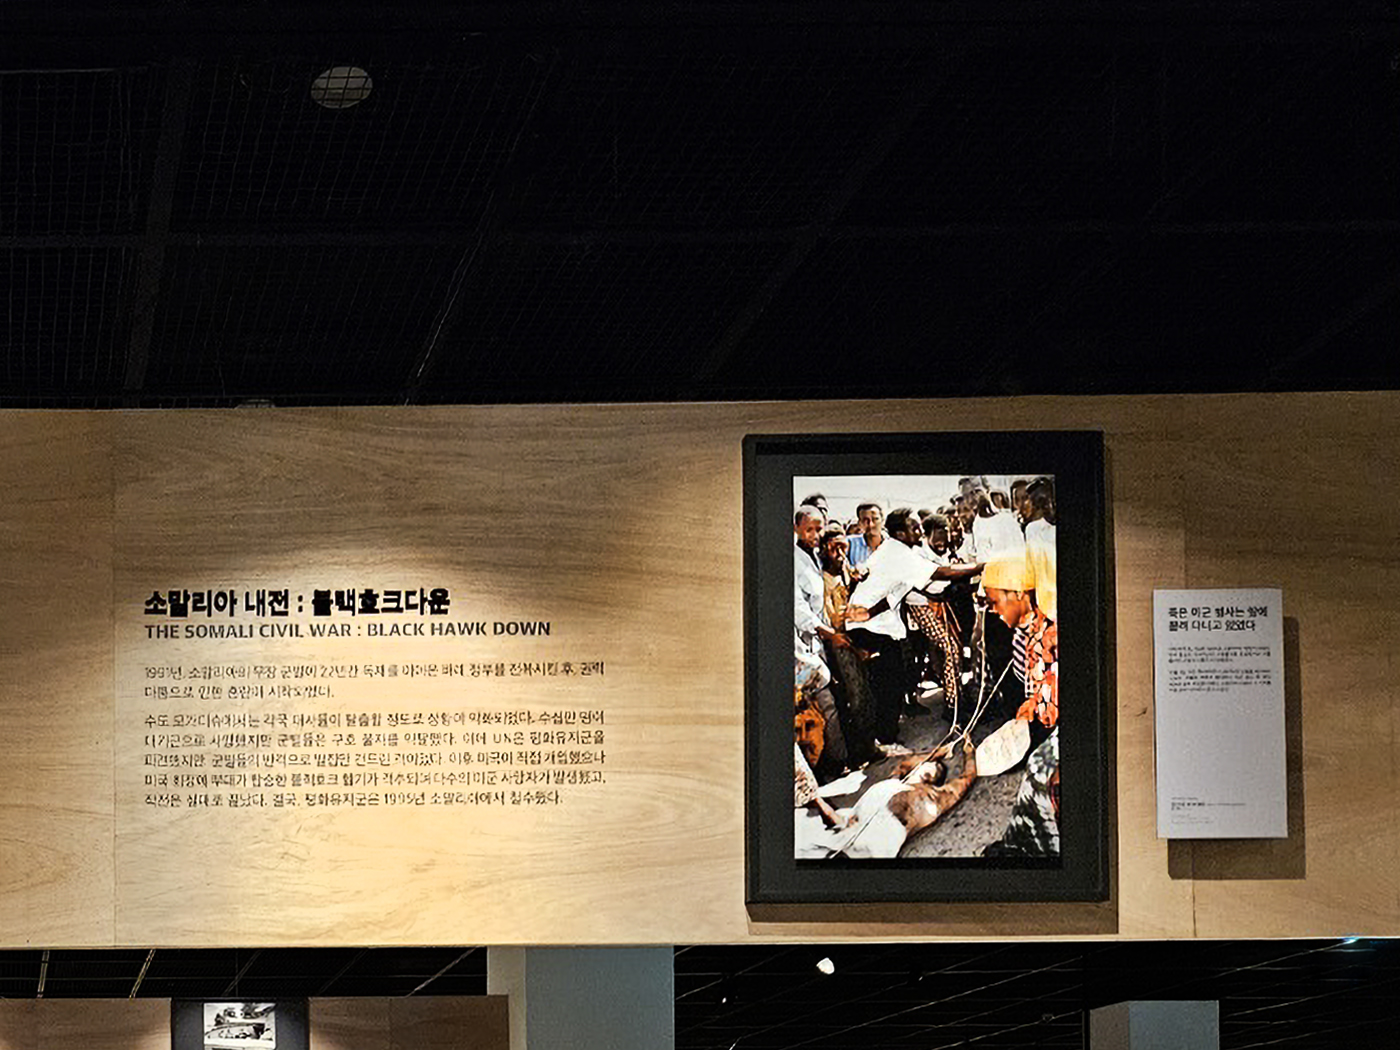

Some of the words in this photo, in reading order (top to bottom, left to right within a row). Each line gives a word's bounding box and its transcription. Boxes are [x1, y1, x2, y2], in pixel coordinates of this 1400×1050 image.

[144, 588, 238, 618] 소말리아
[245, 588, 292, 618] 내전
[298, 595, 304, 613] :
[311, 587, 451, 618] 블랙호크다운
[144, 623, 180, 640] THE
[185, 622, 253, 640] SOMALI
[259, 622, 304, 639] CIVIL
[310, 622, 351, 638] WAR
[357, 625, 362, 637] :
[367, 621, 425, 638] BLACK
[431, 621, 488, 637] HAWK
[493, 620, 551, 637] DOWN
